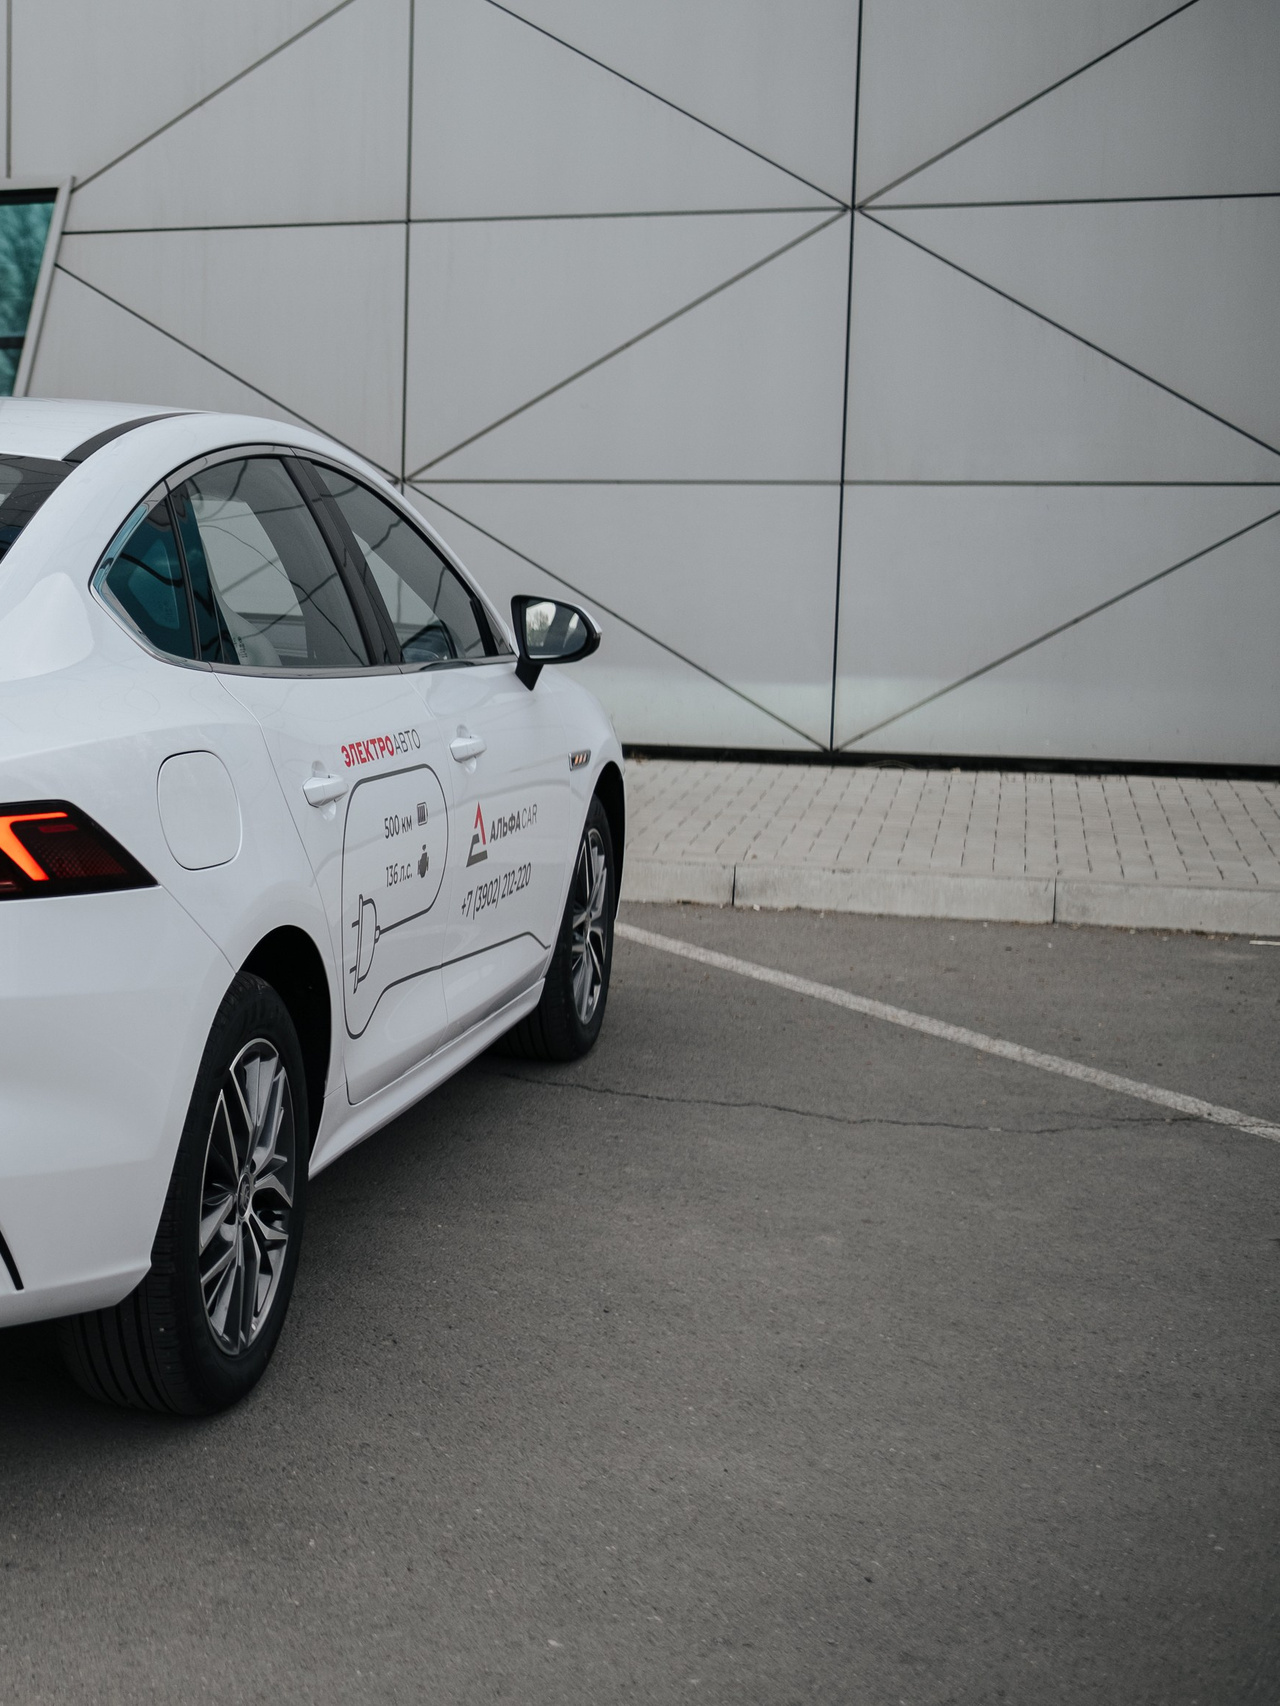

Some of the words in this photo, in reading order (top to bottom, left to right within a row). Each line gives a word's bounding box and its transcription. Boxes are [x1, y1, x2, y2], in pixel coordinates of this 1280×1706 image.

[384, 814, 400, 840] 500
[385, 862, 399, 888] 136
[461, 889, 474, 918] +7
[472, 874, 501, 921] (3902)
[500, 861, 532, 900] 212-220
